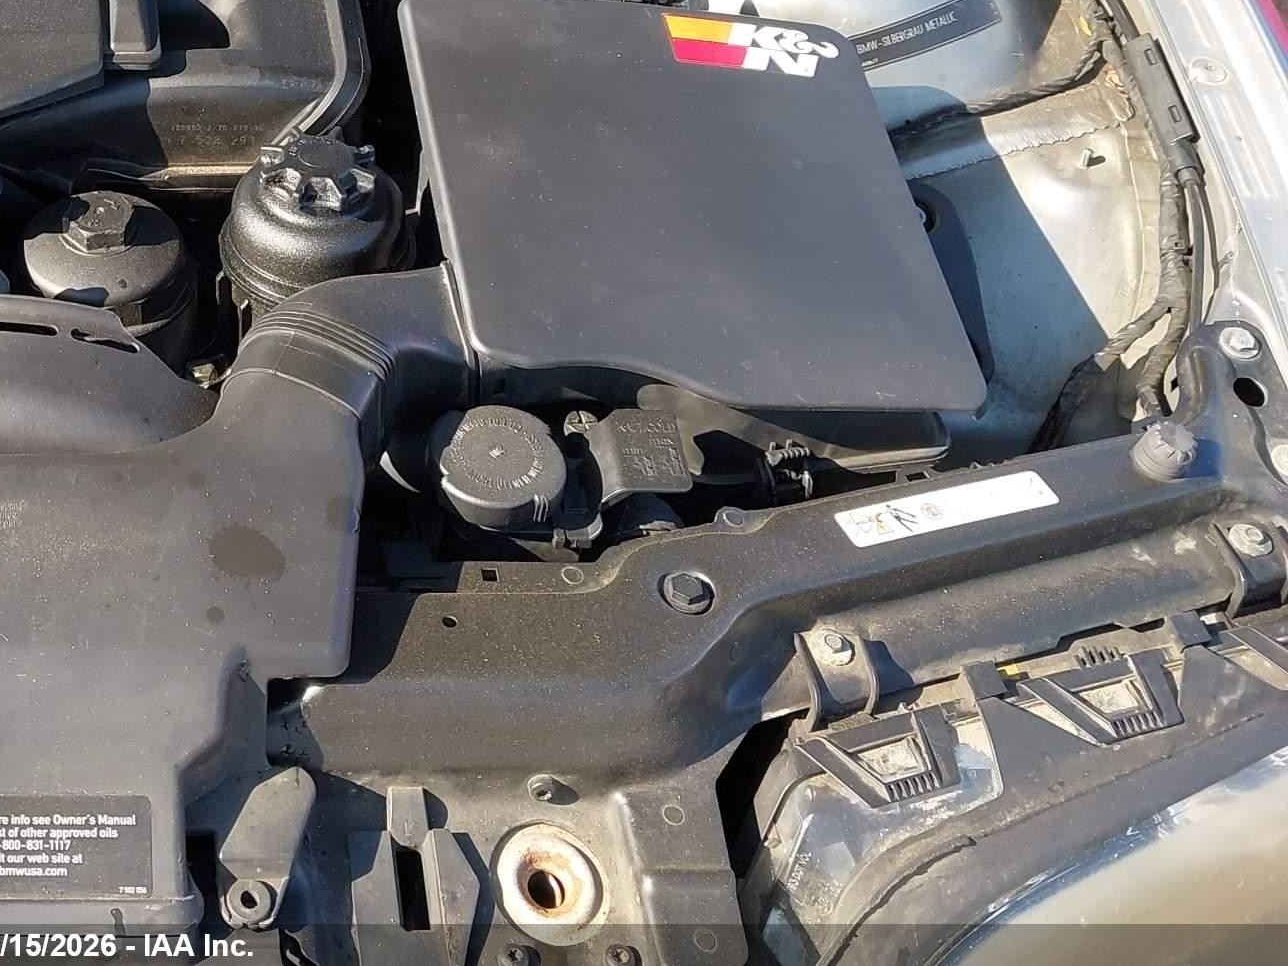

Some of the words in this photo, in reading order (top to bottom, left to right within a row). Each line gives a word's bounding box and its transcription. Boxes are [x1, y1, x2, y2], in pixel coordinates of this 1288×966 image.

[855, 25, 924, 55] BMW-SILBERGRAU
[924, 10, 958, 32] METALLIC
[11, 814, 30, 825] info
[32, 817, 51, 825] see
[98, 814, 136, 825] Manual
[8, 828, 18, 838] of
[21, 828, 47, 838] other
[50, 828, 97, 840] approved
[99, 828, 118, 838] oils
[27, 854, 49, 863] web
[51, 854, 70, 863] site
[72, 854, 83, 863] at
